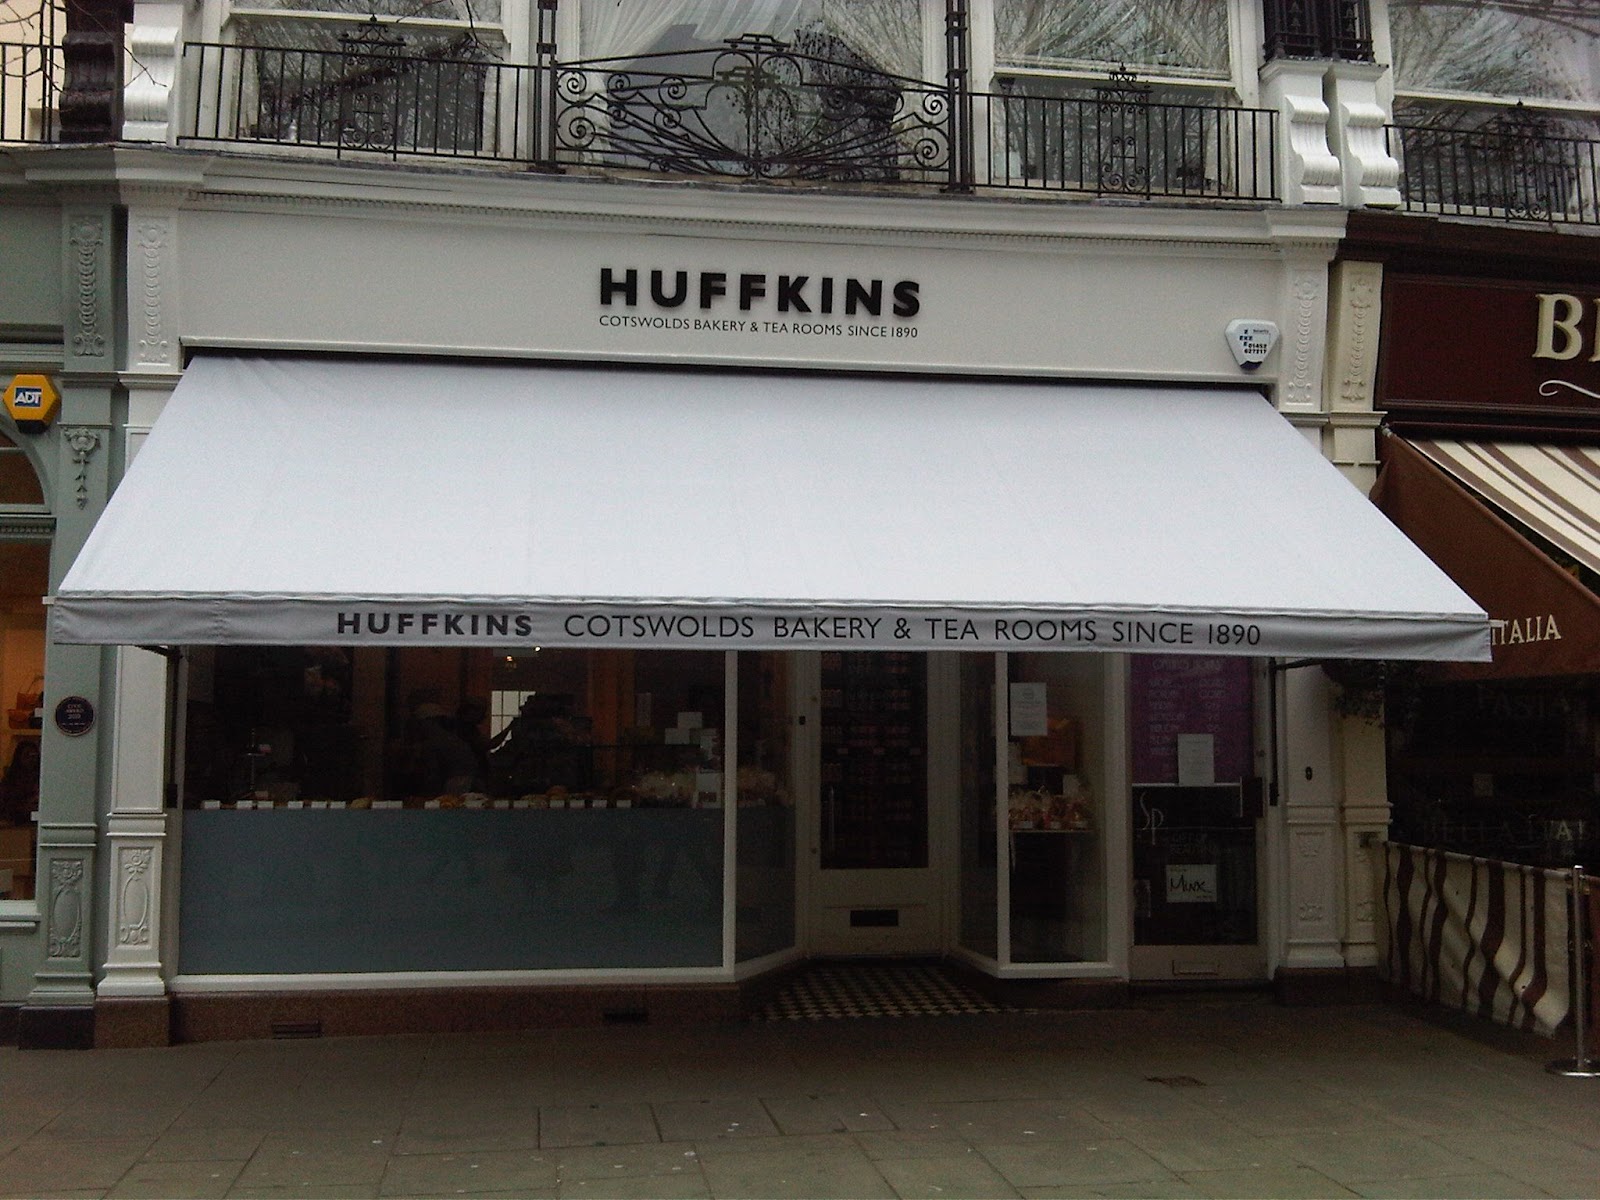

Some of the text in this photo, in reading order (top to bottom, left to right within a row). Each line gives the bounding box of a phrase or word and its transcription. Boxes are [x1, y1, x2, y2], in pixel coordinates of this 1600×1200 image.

[600, 268, 920, 317] HUFFKINS
[599, 315, 918, 338] COTSWOLDS BAKERY & TEA ROOMS SINCE 1890
[1532, 293, 1600, 362] B
[15, 391, 42, 404] ADT
[337, 613, 1261, 645] HUFFKINS COTSWOLDS BAKERY & TEA ROOMS SINCE 1890
[1491, 614, 1562, 646] ITALIA
